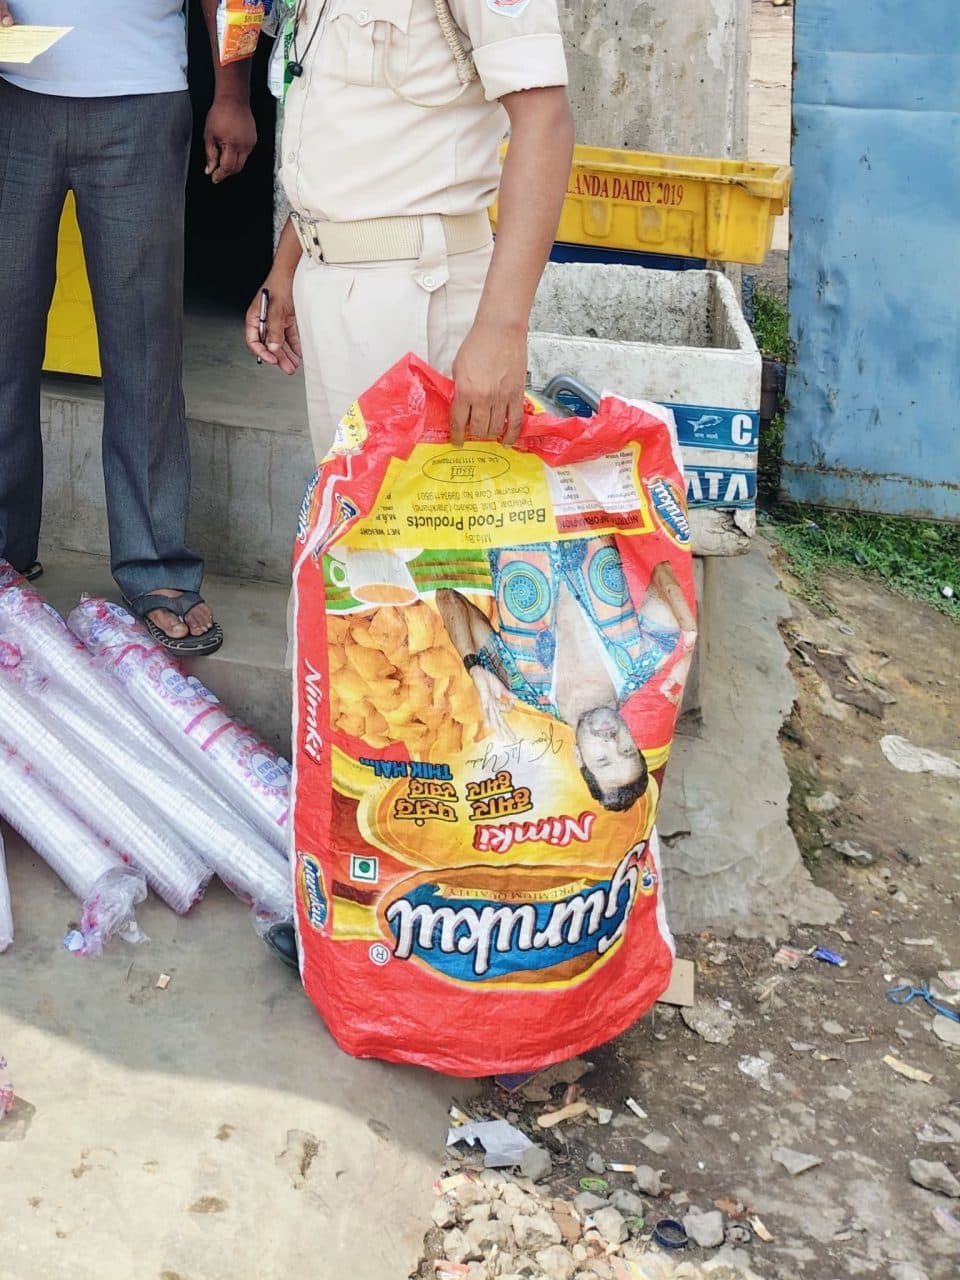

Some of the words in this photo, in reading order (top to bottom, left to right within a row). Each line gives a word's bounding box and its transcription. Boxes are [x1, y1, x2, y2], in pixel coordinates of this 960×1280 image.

[568, 174, 609, 199] ANDA
[612, 177, 654, 203] DAIRY
[656, 183, 684, 207] 2019
[474, 489, 492, 498] Care
[494, 486, 530, 498] Consumer
[685, 470, 749, 501] ATA
[406, 515, 464, 531] Products
[467, 513, 504, 528] Food
[509, 508, 546, 524] Baba
[304, 657, 322, 763] Nimki
[408, 761, 452, 781] THIK
[408, 779, 458, 803] स्वाद
[465, 770, 513, 802] हमार
[394, 799, 458, 827] पसंद
[469, 787, 532, 821] हमार
[474, 812, 596, 855] Nimki
[447, 888, 510, 900] QUALITY
[511, 887, 574, 902] PREMIUM
[385, 841, 645, 975] Gurukul
